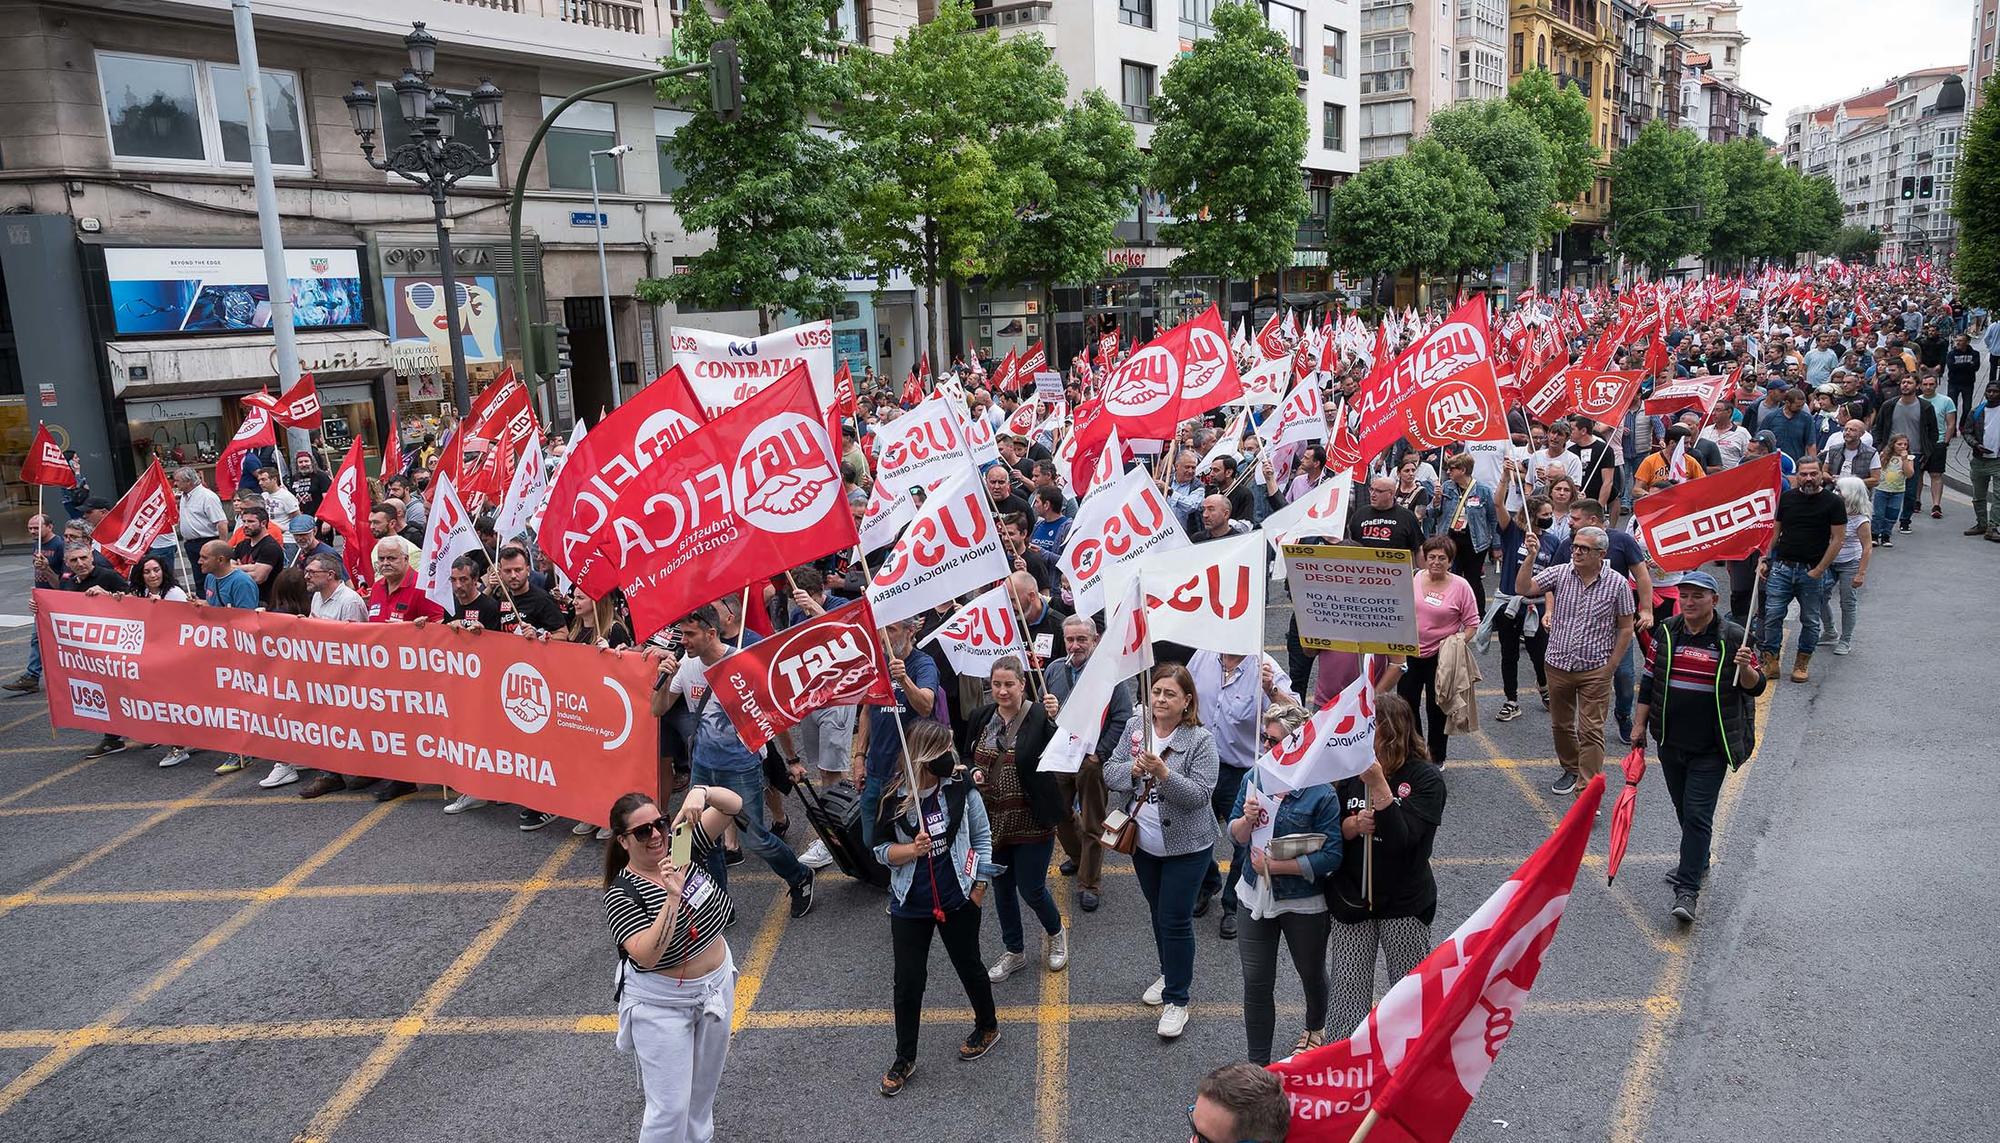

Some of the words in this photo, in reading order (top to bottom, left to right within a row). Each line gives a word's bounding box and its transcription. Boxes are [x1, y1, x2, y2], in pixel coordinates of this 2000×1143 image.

[671, 336, 698, 351] USO
[795, 329, 831, 347] USO
[1470, 443, 1497, 452] adidas
[1363, 526, 1392, 538] USO
[1285, 546, 1315, 555] USO
[1375, 551, 1406, 560] USO
[1295, 562, 1319, 571] SIN
[1323, 564, 1402, 576] CONVENIO
[1304, 573, 1354, 584] DESDE
[1306, 592, 1323, 601] NO
[1325, 594, 1341, 602] AL
[1343, 596, 1401, 606] RECORTE
[1305, 607, 1340, 618] COMO
[1342, 612, 1405, 622] PRETENDE
[1312, 601, 1328, 609] DE
[1331, 603, 1396, 614] DERECHOS
[1314, 615, 1330, 623] LA
[56, 619, 121, 646] CCOO
[1304, 637, 1332, 646] USO
[1387, 643, 1416, 652] USO
[179, 623, 229, 649] POR
[233, 628, 257, 655] UN
[262, 634, 390, 669] CONVENIO
[398, 646, 482, 679] DIGNO
[58, 645, 140, 680] industria
[215, 667, 268, 698] PARA
[274, 676, 301, 703] LA
[307, 681, 449, 718] INDUSTRIA
[507, 672, 544, 705] UGT
[70, 684, 106, 709] USO
[556, 691, 589, 713] FICA
[557, 719, 595, 733] Construcción
[600, 728, 615, 738] Agro
[119, 696, 365, 752] SIDEROMETALÚRGICA
[371, 731, 407, 756] DE
[416, 734, 558, 787] CANTABRIA
[926, 813, 943, 824] UGT
[965, 859, 974, 874] UGT
[682, 883, 699, 899] UGT
